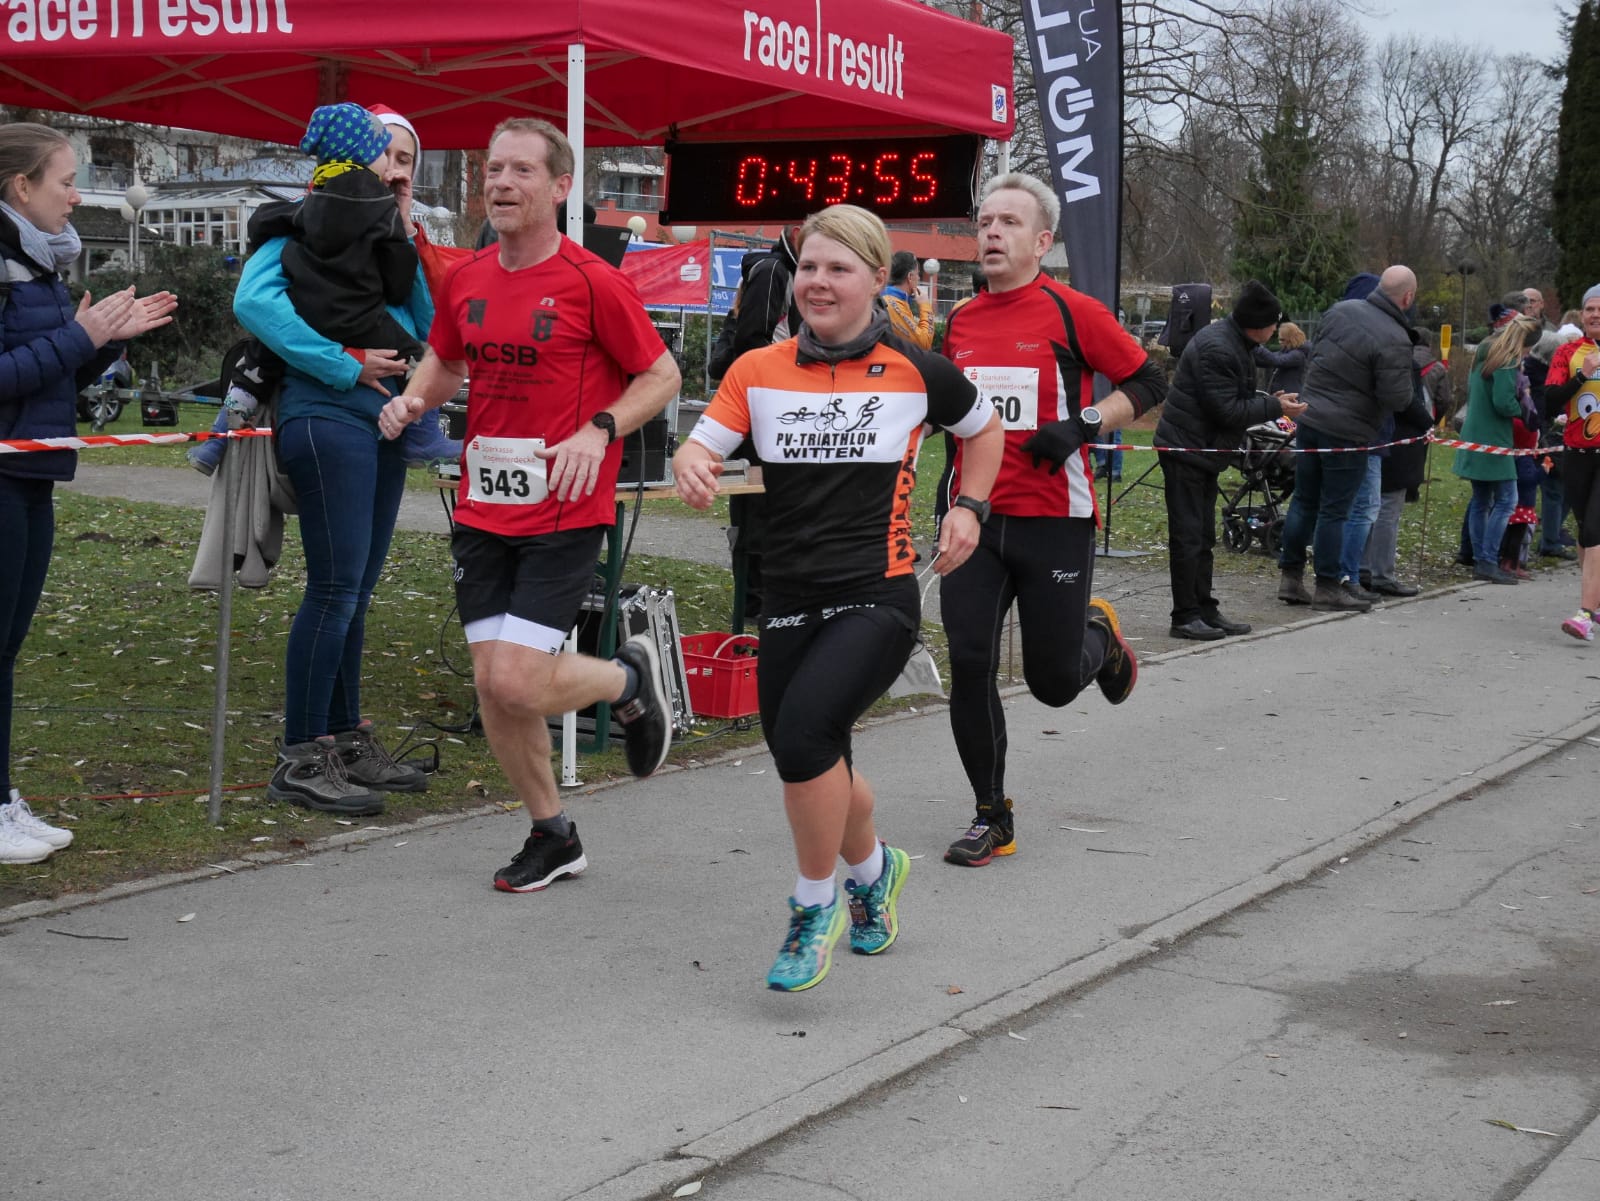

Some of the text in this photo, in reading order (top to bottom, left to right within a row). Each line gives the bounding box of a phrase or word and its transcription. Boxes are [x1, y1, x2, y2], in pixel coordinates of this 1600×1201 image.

[0, 0, 97, 41] ace
[744, 9, 905, 100] race result
[735, 151, 939, 206] 0:43:55
[481, 342, 538, 366] CSB
[776, 432, 877, 447] PV-TRIATHLON
[782, 447, 865, 458] WITTEN
[480, 467, 530, 498] 543
